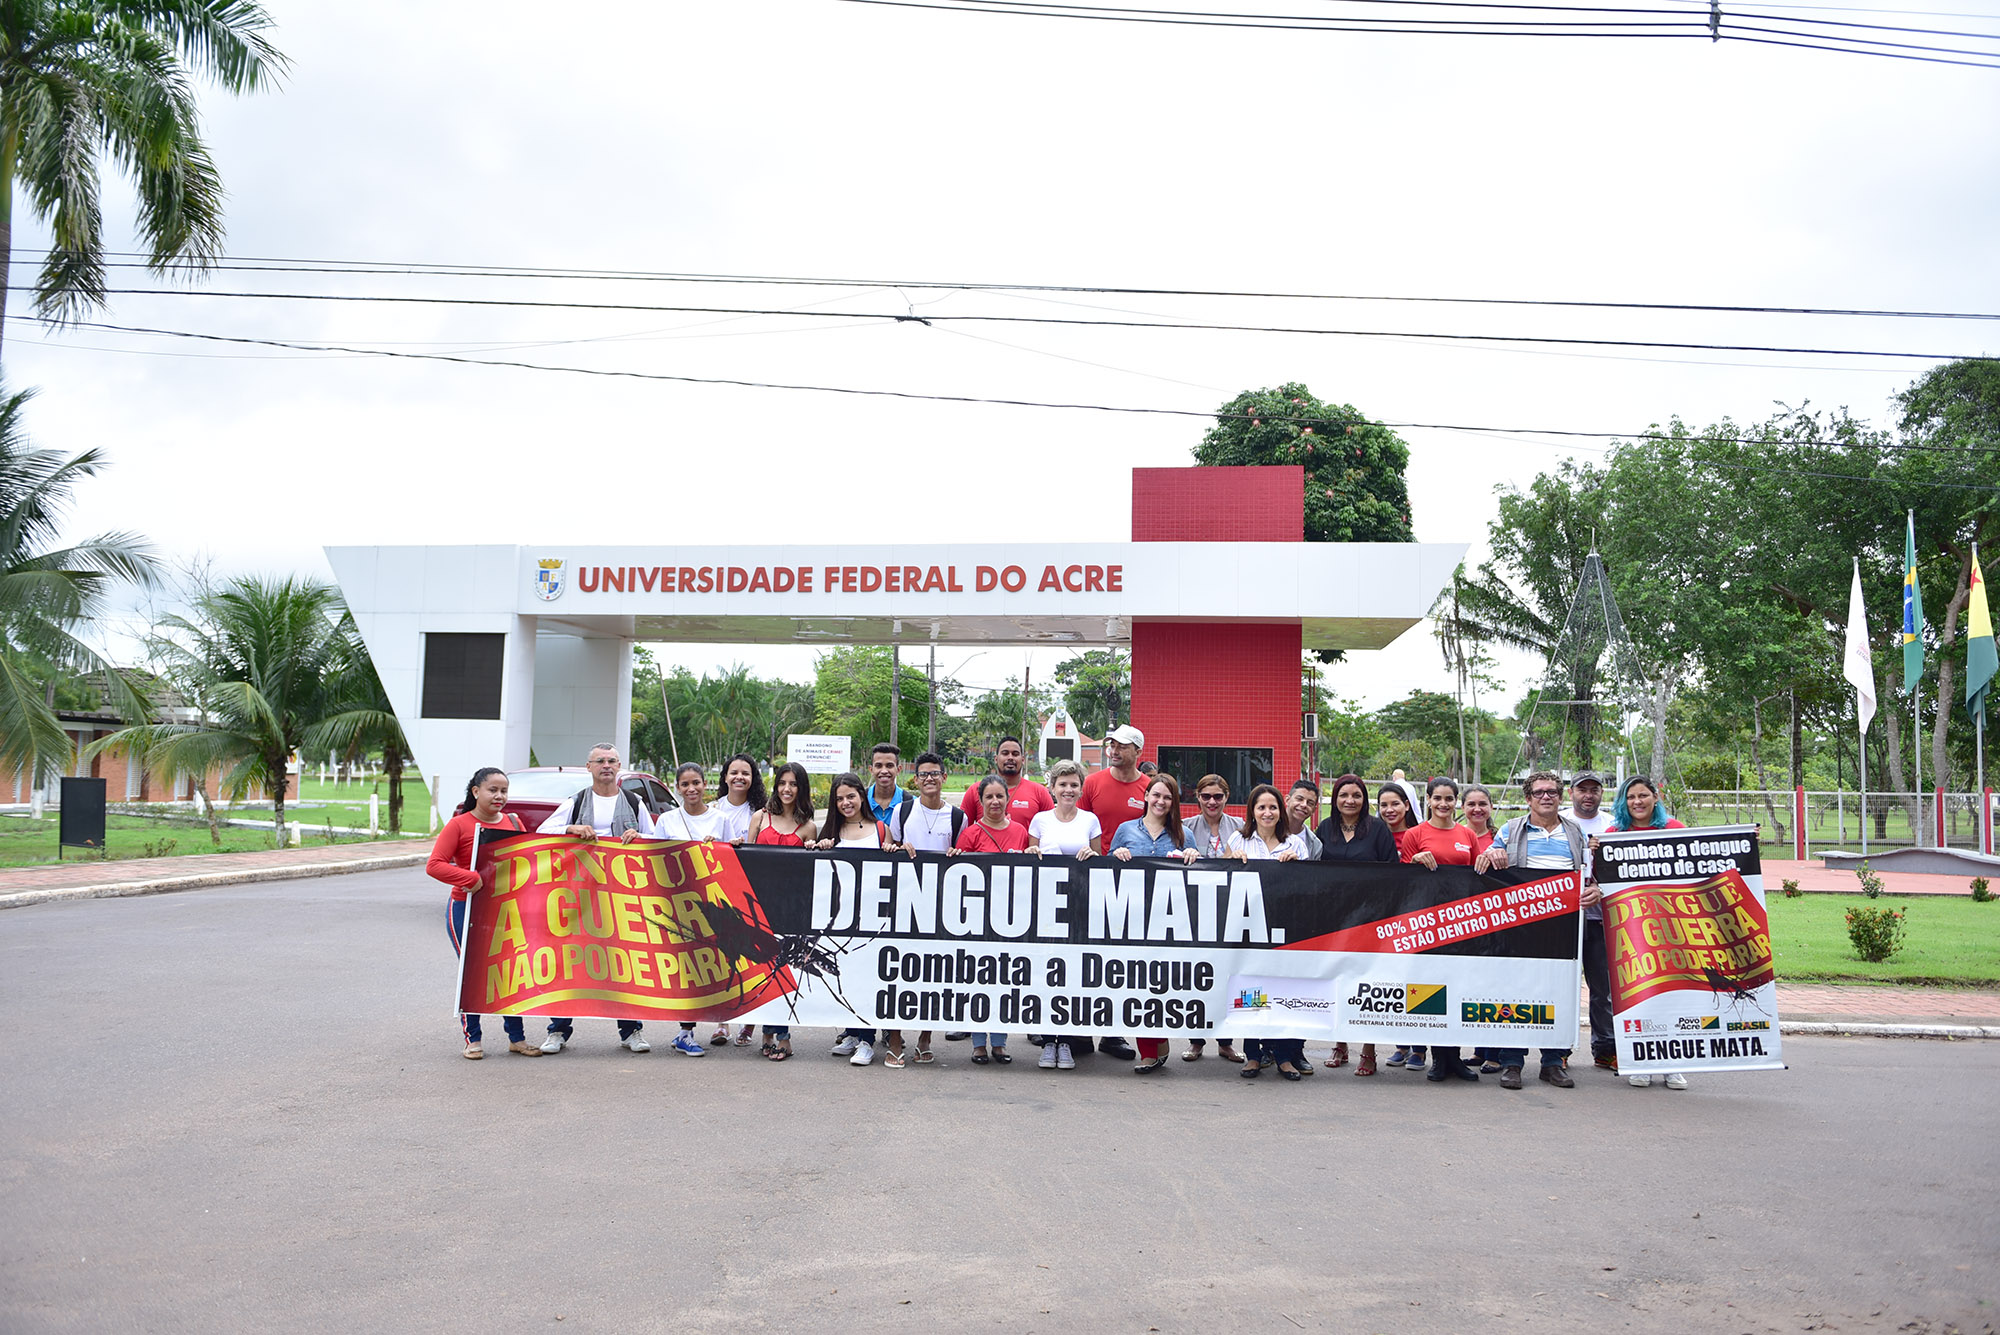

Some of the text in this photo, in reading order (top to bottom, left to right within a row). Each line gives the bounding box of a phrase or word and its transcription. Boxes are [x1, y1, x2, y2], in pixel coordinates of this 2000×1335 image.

[578, 565, 1123, 594] UNIVERSIDADE FEDERAL DO ACRE
[491, 841, 723, 897] DENGUE
[1602, 839, 1751, 862] Combata a dengue
[1617, 858, 1741, 879] dentro de casa.
[811, 859, 1286, 944] DENGUE MATA.
[1376, 876, 1575, 940] 80% DOS FOCOS DO MOSQUITO
[1393, 897, 1567, 953] ESTÃO DENTRO DAS CASAS.
[1607, 882, 1743, 928] DENGUE
[488, 901, 526, 957] A
[1614, 905, 1760, 961] A GUERRA
[486, 943, 557, 1004] NÃO
[563, 943, 655, 989] PODE
[878, 945, 1214, 995] Combata a Dengue
[1617, 933, 1771, 988] NÃO PODE PARAR
[875, 983, 1214, 1030] dentro da sua casa.
[1348, 996, 1405, 1013] do Acre
[1357, 982, 1405, 999] Povo
[1461, 1002, 1554, 1024] BRASIL
[1632, 1036, 1768, 1061] DENGUE MATA.
[1726, 1021, 1770, 1031] BRASIL
